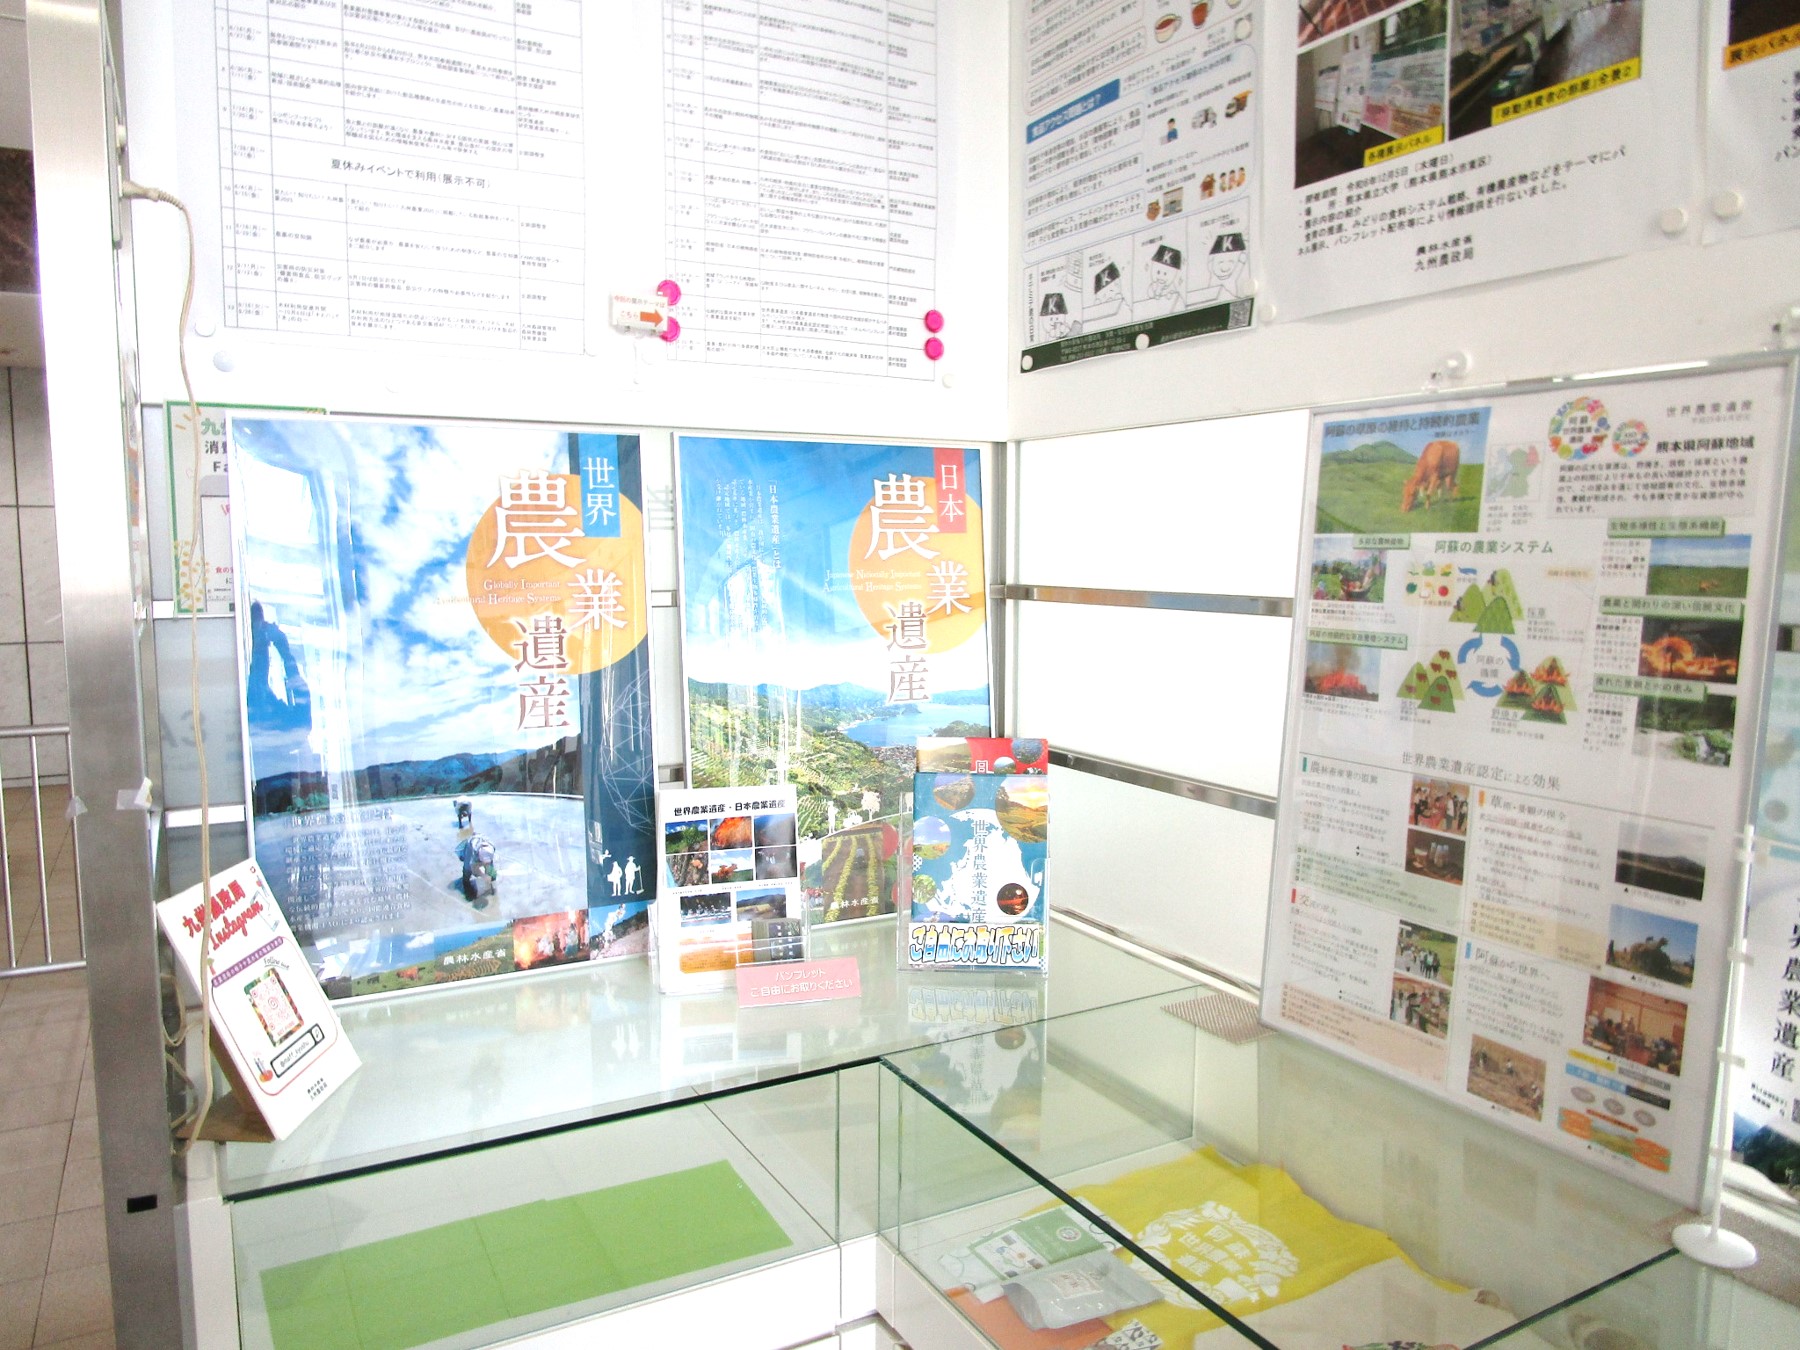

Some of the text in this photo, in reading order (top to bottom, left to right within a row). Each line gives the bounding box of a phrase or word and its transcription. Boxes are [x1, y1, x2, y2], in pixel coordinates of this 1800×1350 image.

[1369, 136, 1432, 163] 各種展示パネル
[1416, 234, 1473, 256] 農林水産省
[1414, 246, 1475, 272] 九州農政局
[1326, 412, 1480, 437] 阿蘇の草原の維持と持続的農業
[1656, 435, 1755, 454] 熊本県阿蘇地域
[583, 457, 616, 526] 世界
[939, 464, 965, 522] 日本
[1434, 539, 1553, 554] 阿蘇の農業システム
[483, 577, 561, 591] Globally Important
[865, 582, 894, 593] Heritage
[895, 582, 922, 592] Systems
[488, 593, 524, 606] Heritage
[526, 592, 561, 605] Systems
[1401, 751, 1560, 792] 世界農業遺産認定による効果
[674, 799, 786, 817] 世界農業遺産・日本農業遺産
[971, 819, 989, 924] 世界農業遺産
[208, 901, 264, 950] Instagram
[909, 924, 1039, 965] ご自由にお取り下さい
[443, 948, 507, 967] 農林水産省
[776, 968, 827, 981] パンフレット
[750, 980, 853, 997] ご自由にお取りください
